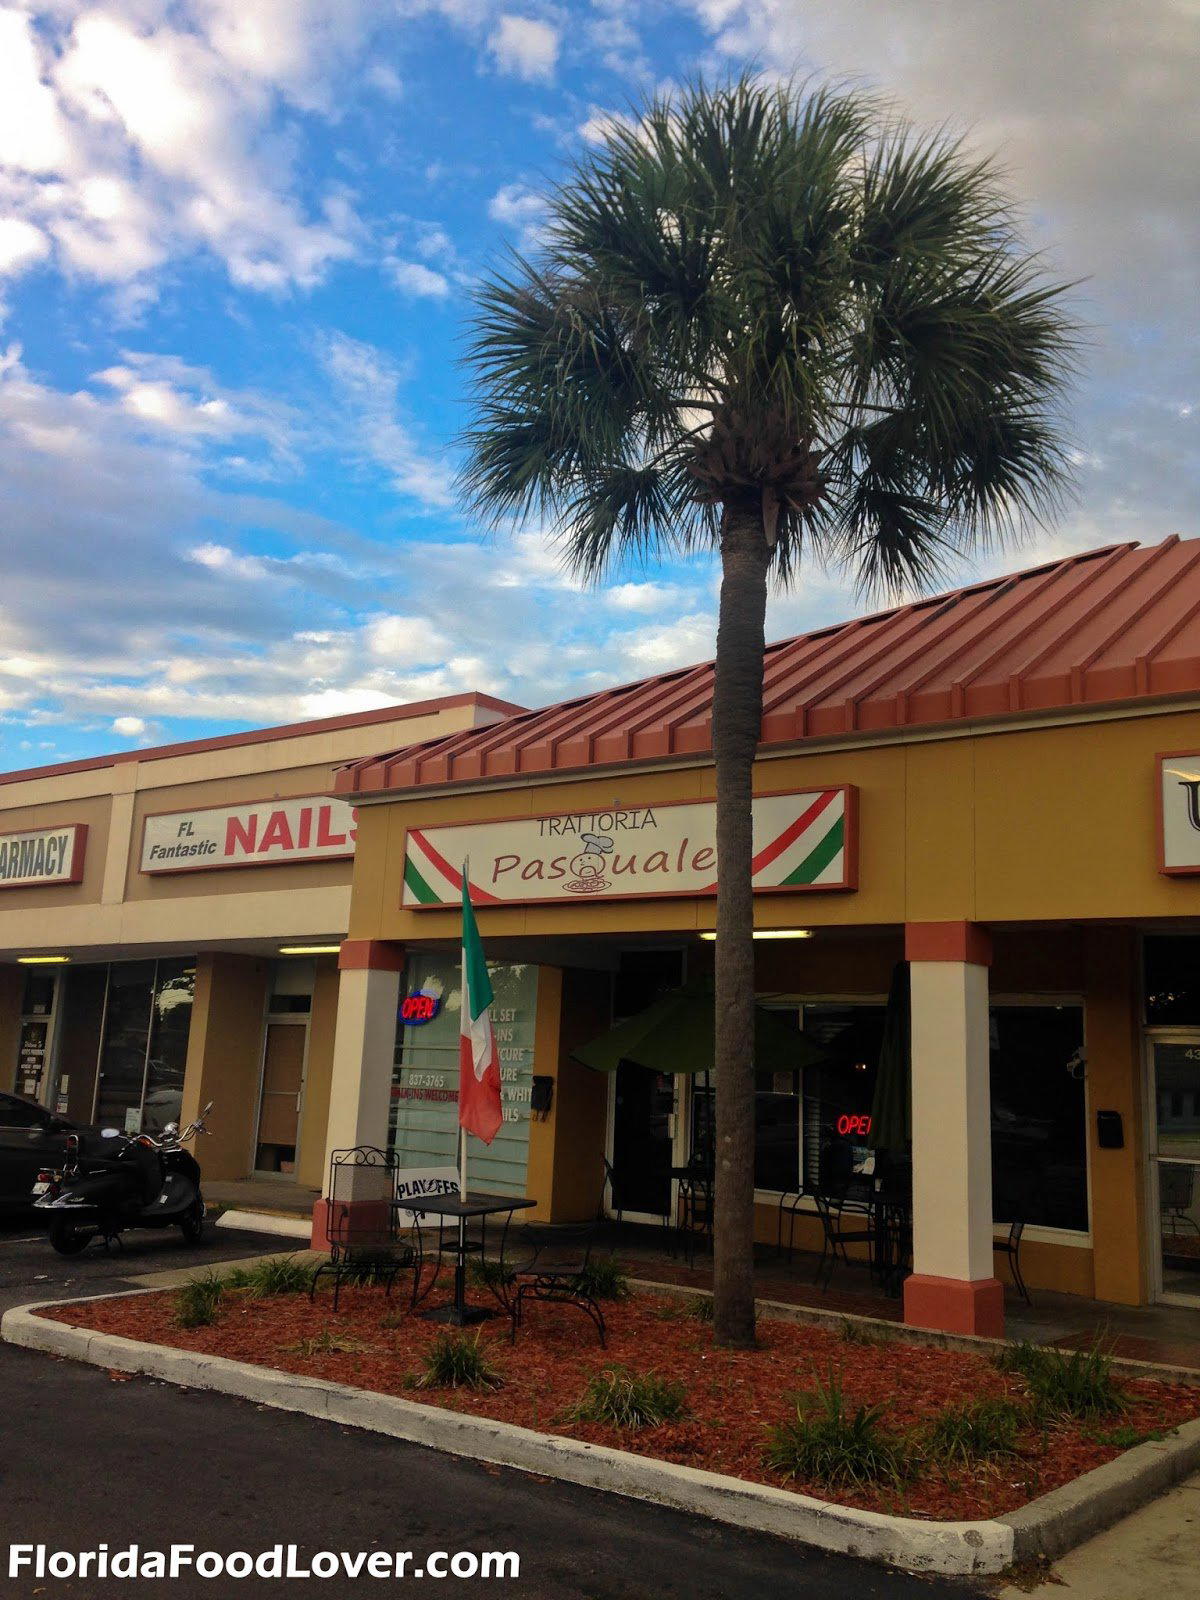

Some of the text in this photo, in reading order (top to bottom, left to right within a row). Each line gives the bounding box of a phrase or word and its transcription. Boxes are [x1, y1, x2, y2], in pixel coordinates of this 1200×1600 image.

[177, 821, 195, 838] FL
[536, 808, 658, 837] TRATTORIA
[0, 835, 68, 880] ARMACY
[149, 840, 217, 860] Fantastic
[402, 996, 435, 1019] OPEN
[408, 1074, 444, 1088] 837-3765
[508, 1087, 532, 1102] WHIT
